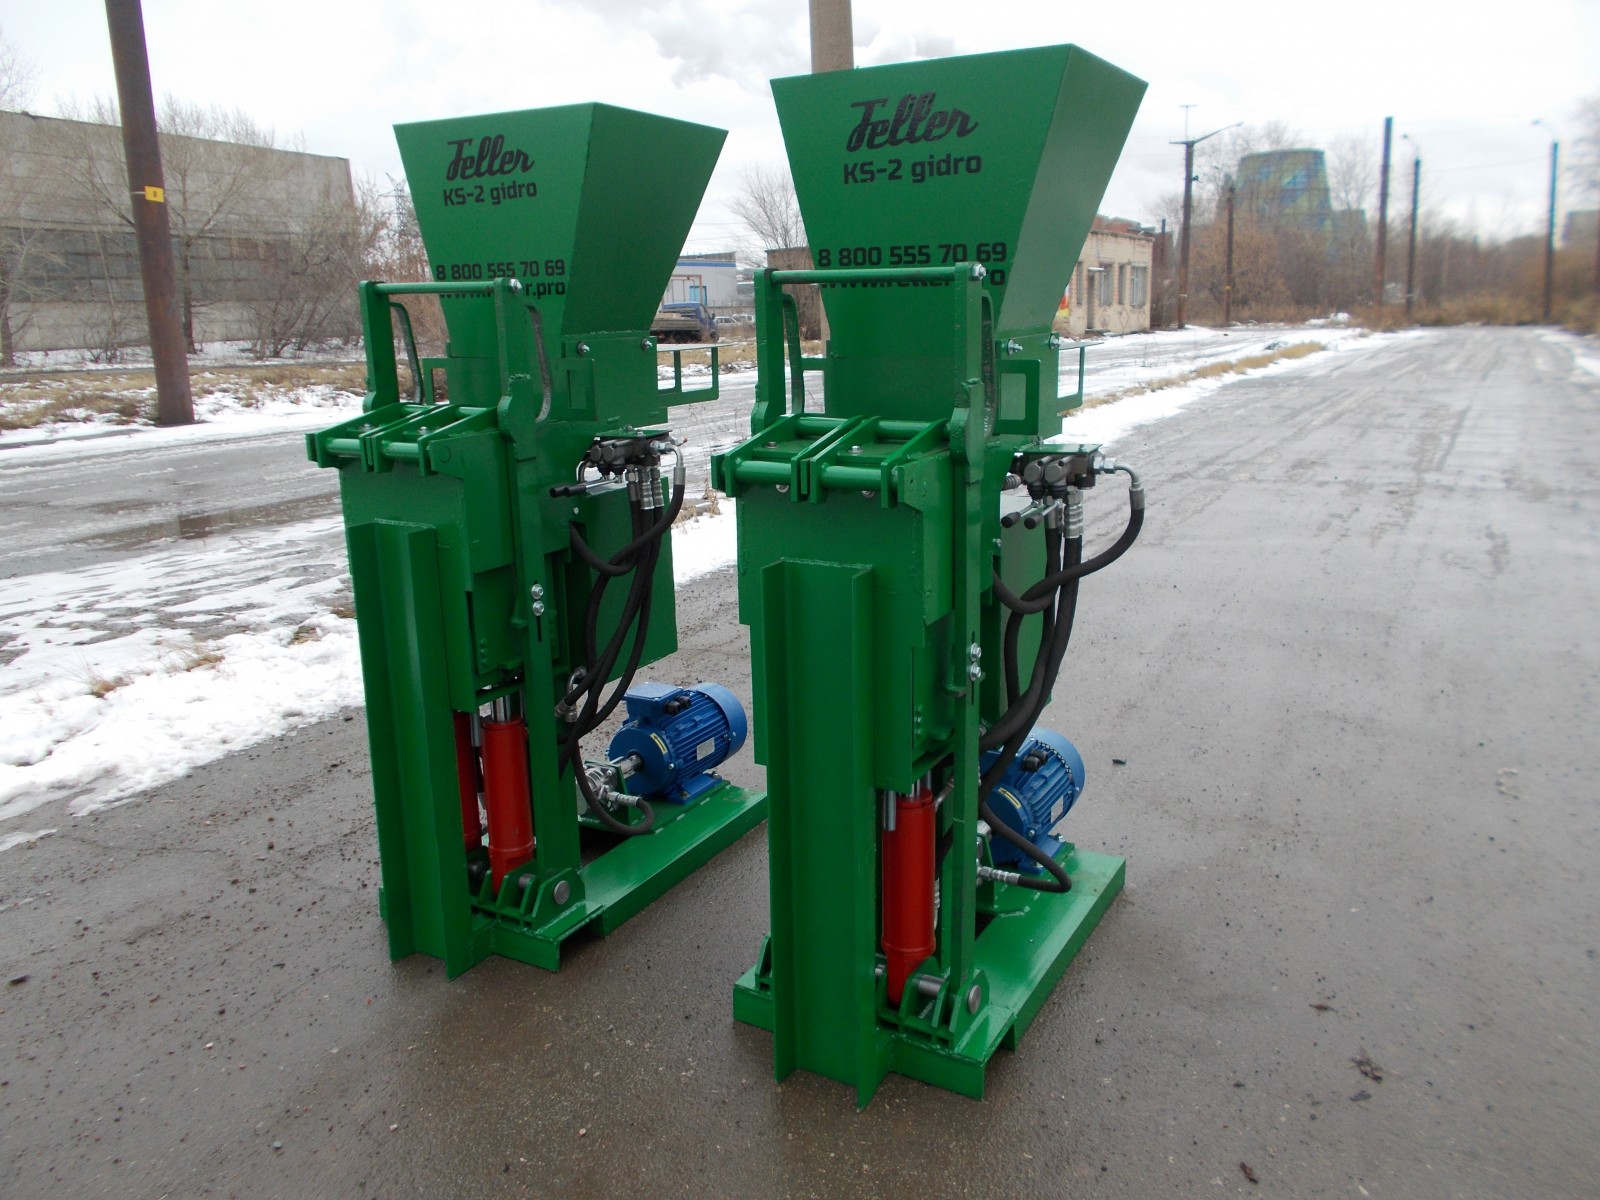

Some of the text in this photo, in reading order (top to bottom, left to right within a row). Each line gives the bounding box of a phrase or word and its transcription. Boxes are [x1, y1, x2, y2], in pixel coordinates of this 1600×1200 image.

[843, 153, 983, 185] KS-2 gidro
[443, 180, 538, 207] KS-2 gidro
[818, 241, 1007, 268] 8 800 555 70 69
[436, 258, 566, 281] 8 800 555 70 69
